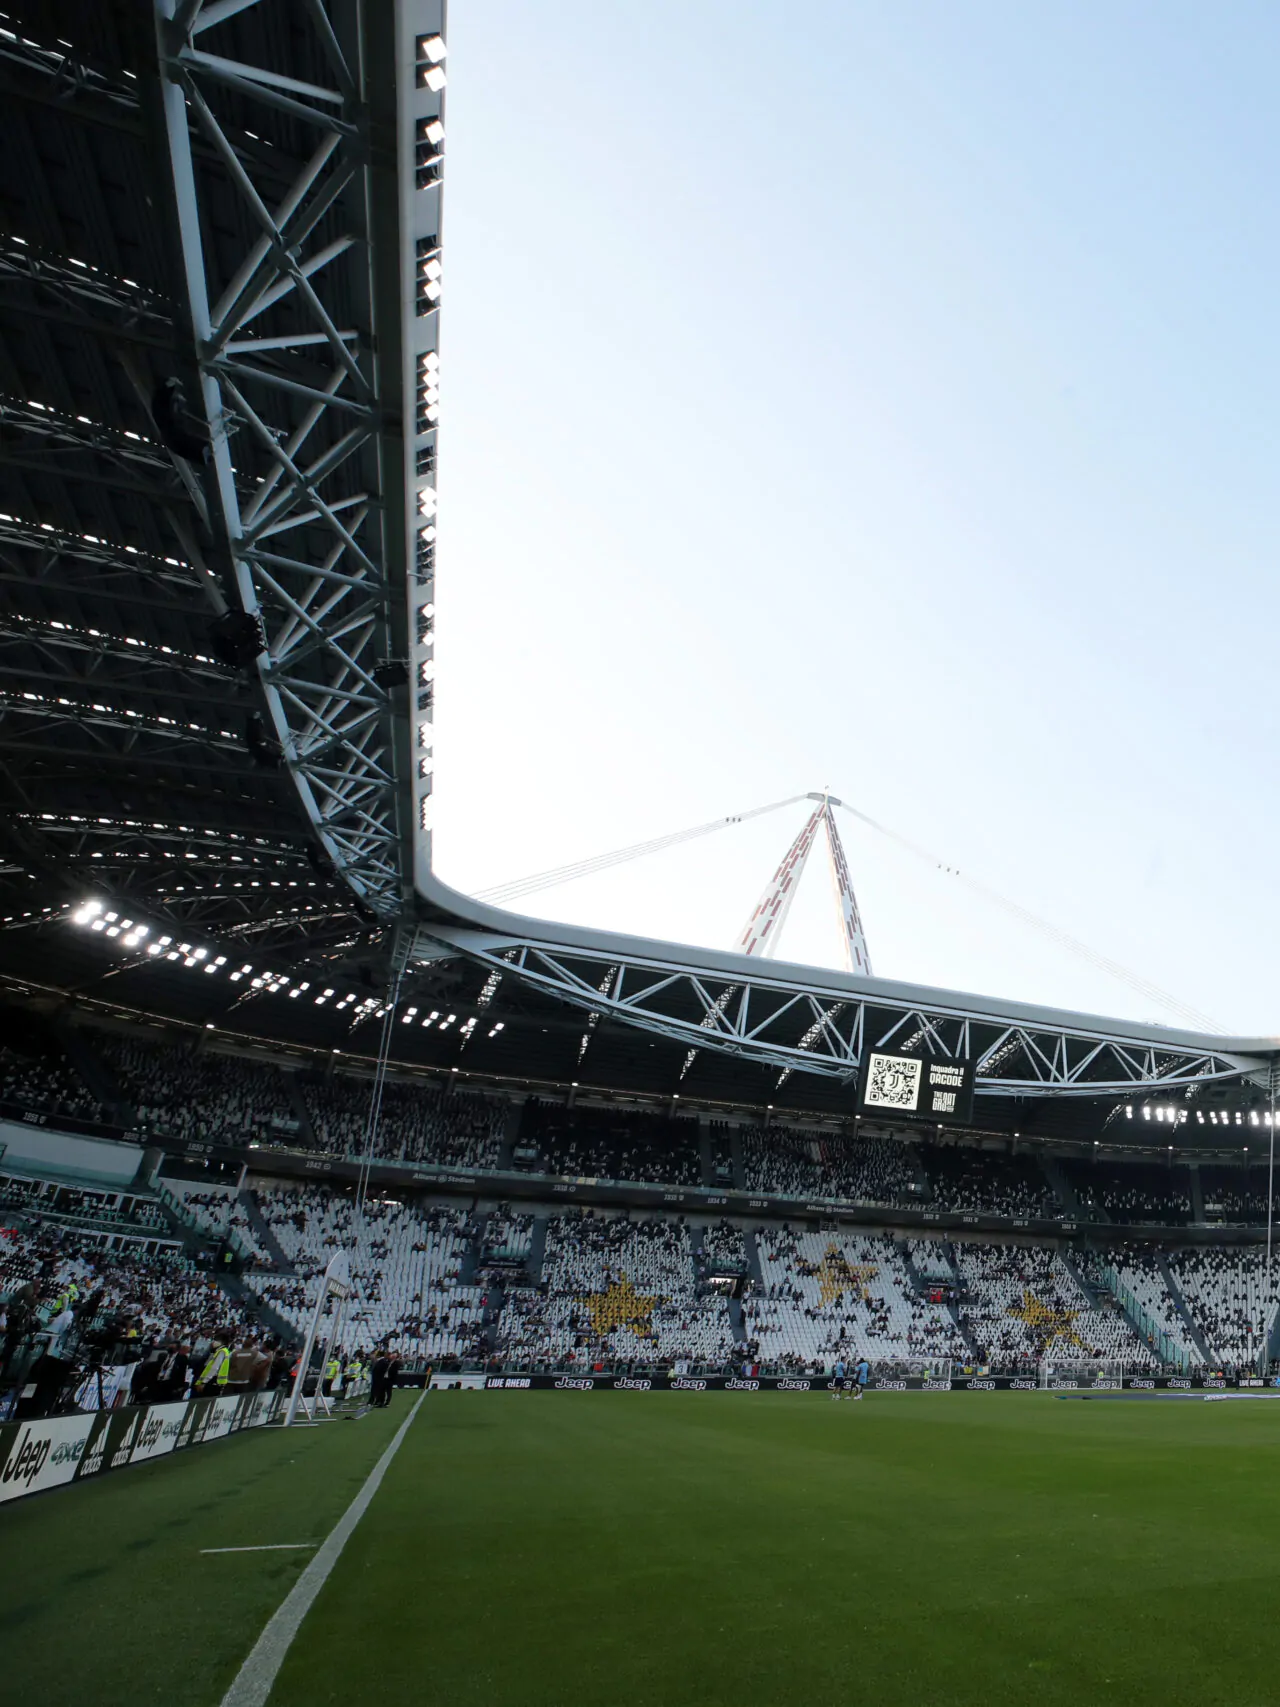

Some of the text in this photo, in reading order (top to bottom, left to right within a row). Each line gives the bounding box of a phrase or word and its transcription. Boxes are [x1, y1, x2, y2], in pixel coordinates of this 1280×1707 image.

[929, 1072, 963, 1088] QRCODE
[412, 1173, 476, 1184] Allianz Stadium
[487, 1378, 531, 1389] LIVE AHEAD
[555, 1377, 594, 1391] Jeep
[614, 1377, 651, 1391] Jeep
[671, 1377, 707, 1391] Jeep
[725, 1377, 760, 1391] Jeep
[777, 1378, 810, 1391] Jeep
[876, 1378, 907, 1391] Jeep
[922, 1379, 951, 1391] Jeep
[967, 1379, 995, 1391] Jeep
[1010, 1379, 1037, 1391] Jeep
[1052, 1379, 1078, 1391] Jeep
[1092, 1379, 1118, 1391] Jeep
[1130, 1379, 1155, 1391] Jeep
[1167, 1378, 1191, 1390] Jeep
[1203, 1378, 1226, 1389] Jeep
[136, 1410, 164, 1454] Jeep
[2, 1428, 52, 1488] Jeep
